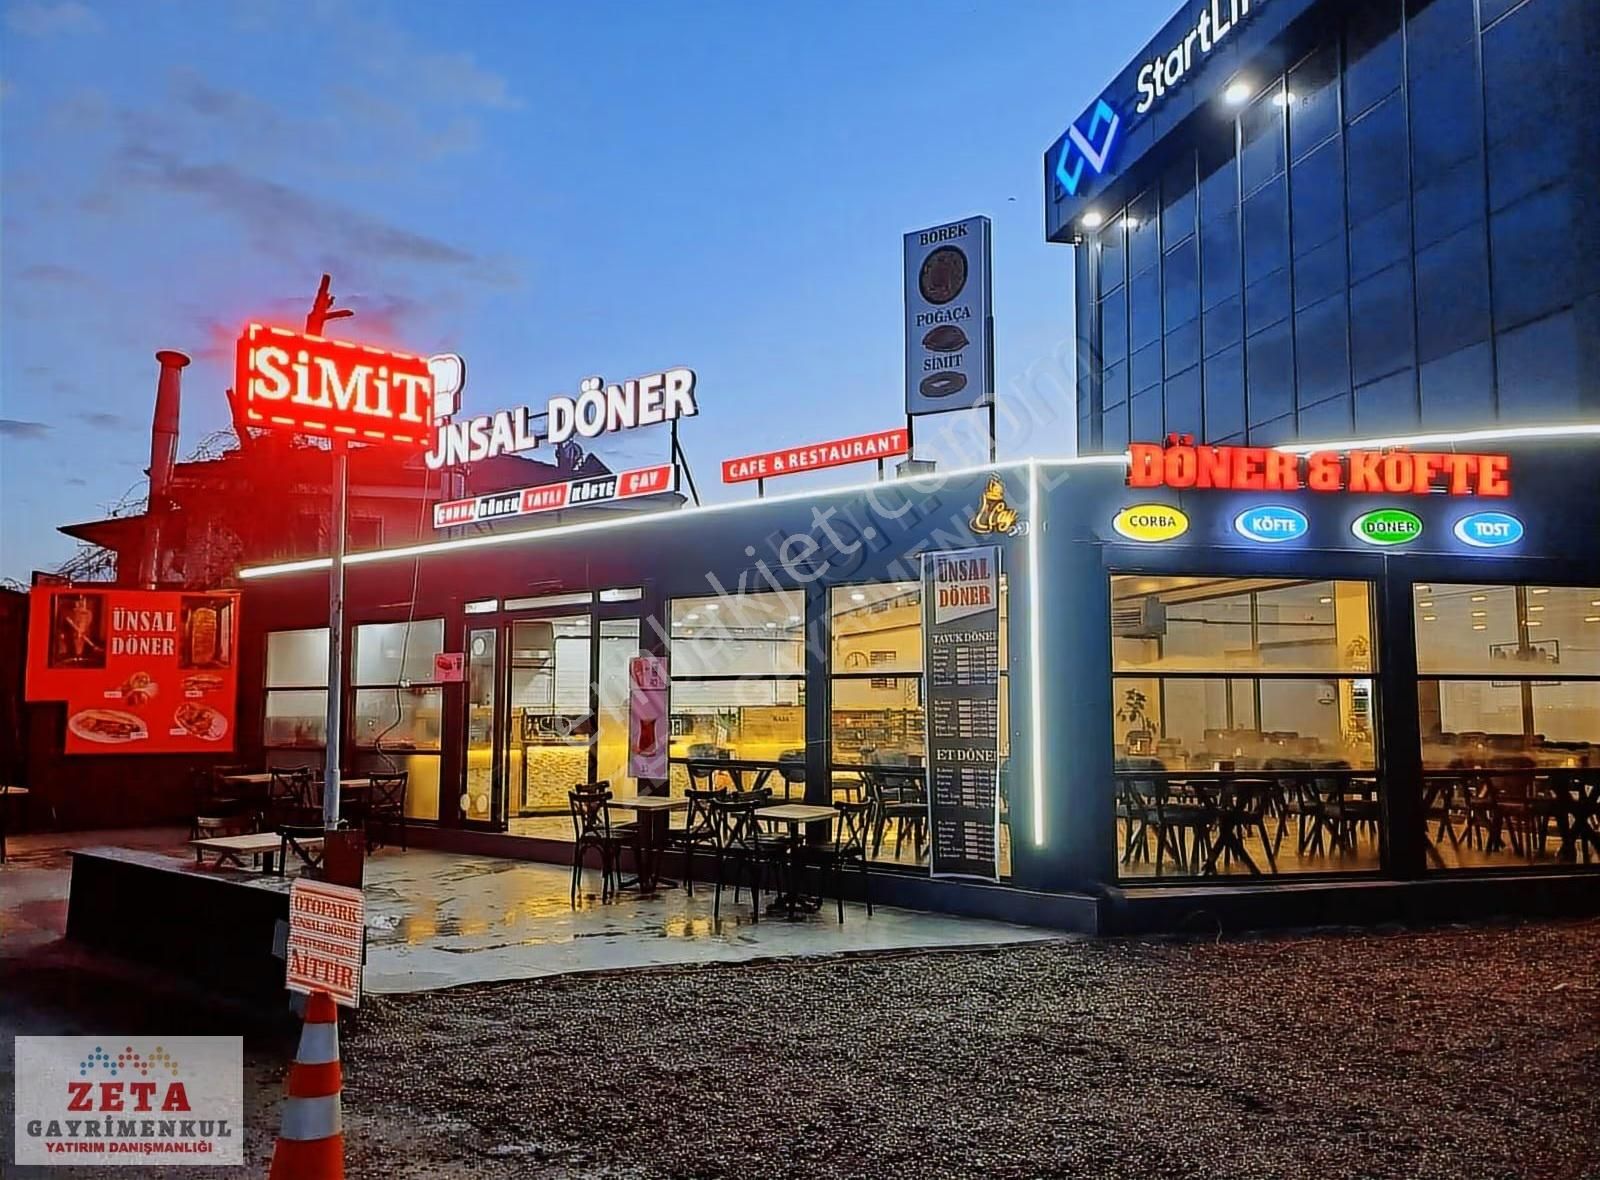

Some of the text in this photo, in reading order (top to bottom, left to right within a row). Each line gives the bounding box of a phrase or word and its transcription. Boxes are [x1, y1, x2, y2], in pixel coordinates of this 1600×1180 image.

[1135, 0, 1249, 114] StartLi
[547, 367, 697, 443] DÖNER
[729, 434, 902, 478] CAFE & RESTAURANT
[1127, 430, 1511, 496] DÖNER & KÖFTE
[629, 469, 658, 493] ÇAY
[1252, 515, 1297, 532] KÖFTE
[1474, 522, 1511, 537] TOST
[938, 557, 991, 583] ÜNSAL
[939, 584, 992, 608] DÖNER
[112, 606, 177, 632] ÜNSAL
[111, 634, 175, 656] DÖNER
[964, 630, 995, 643] DÖNE
[936, 748, 996, 763] ET DÖNE
[294, 894, 358, 923] OTOPARK
[290, 948, 354, 990] AİTTİR
